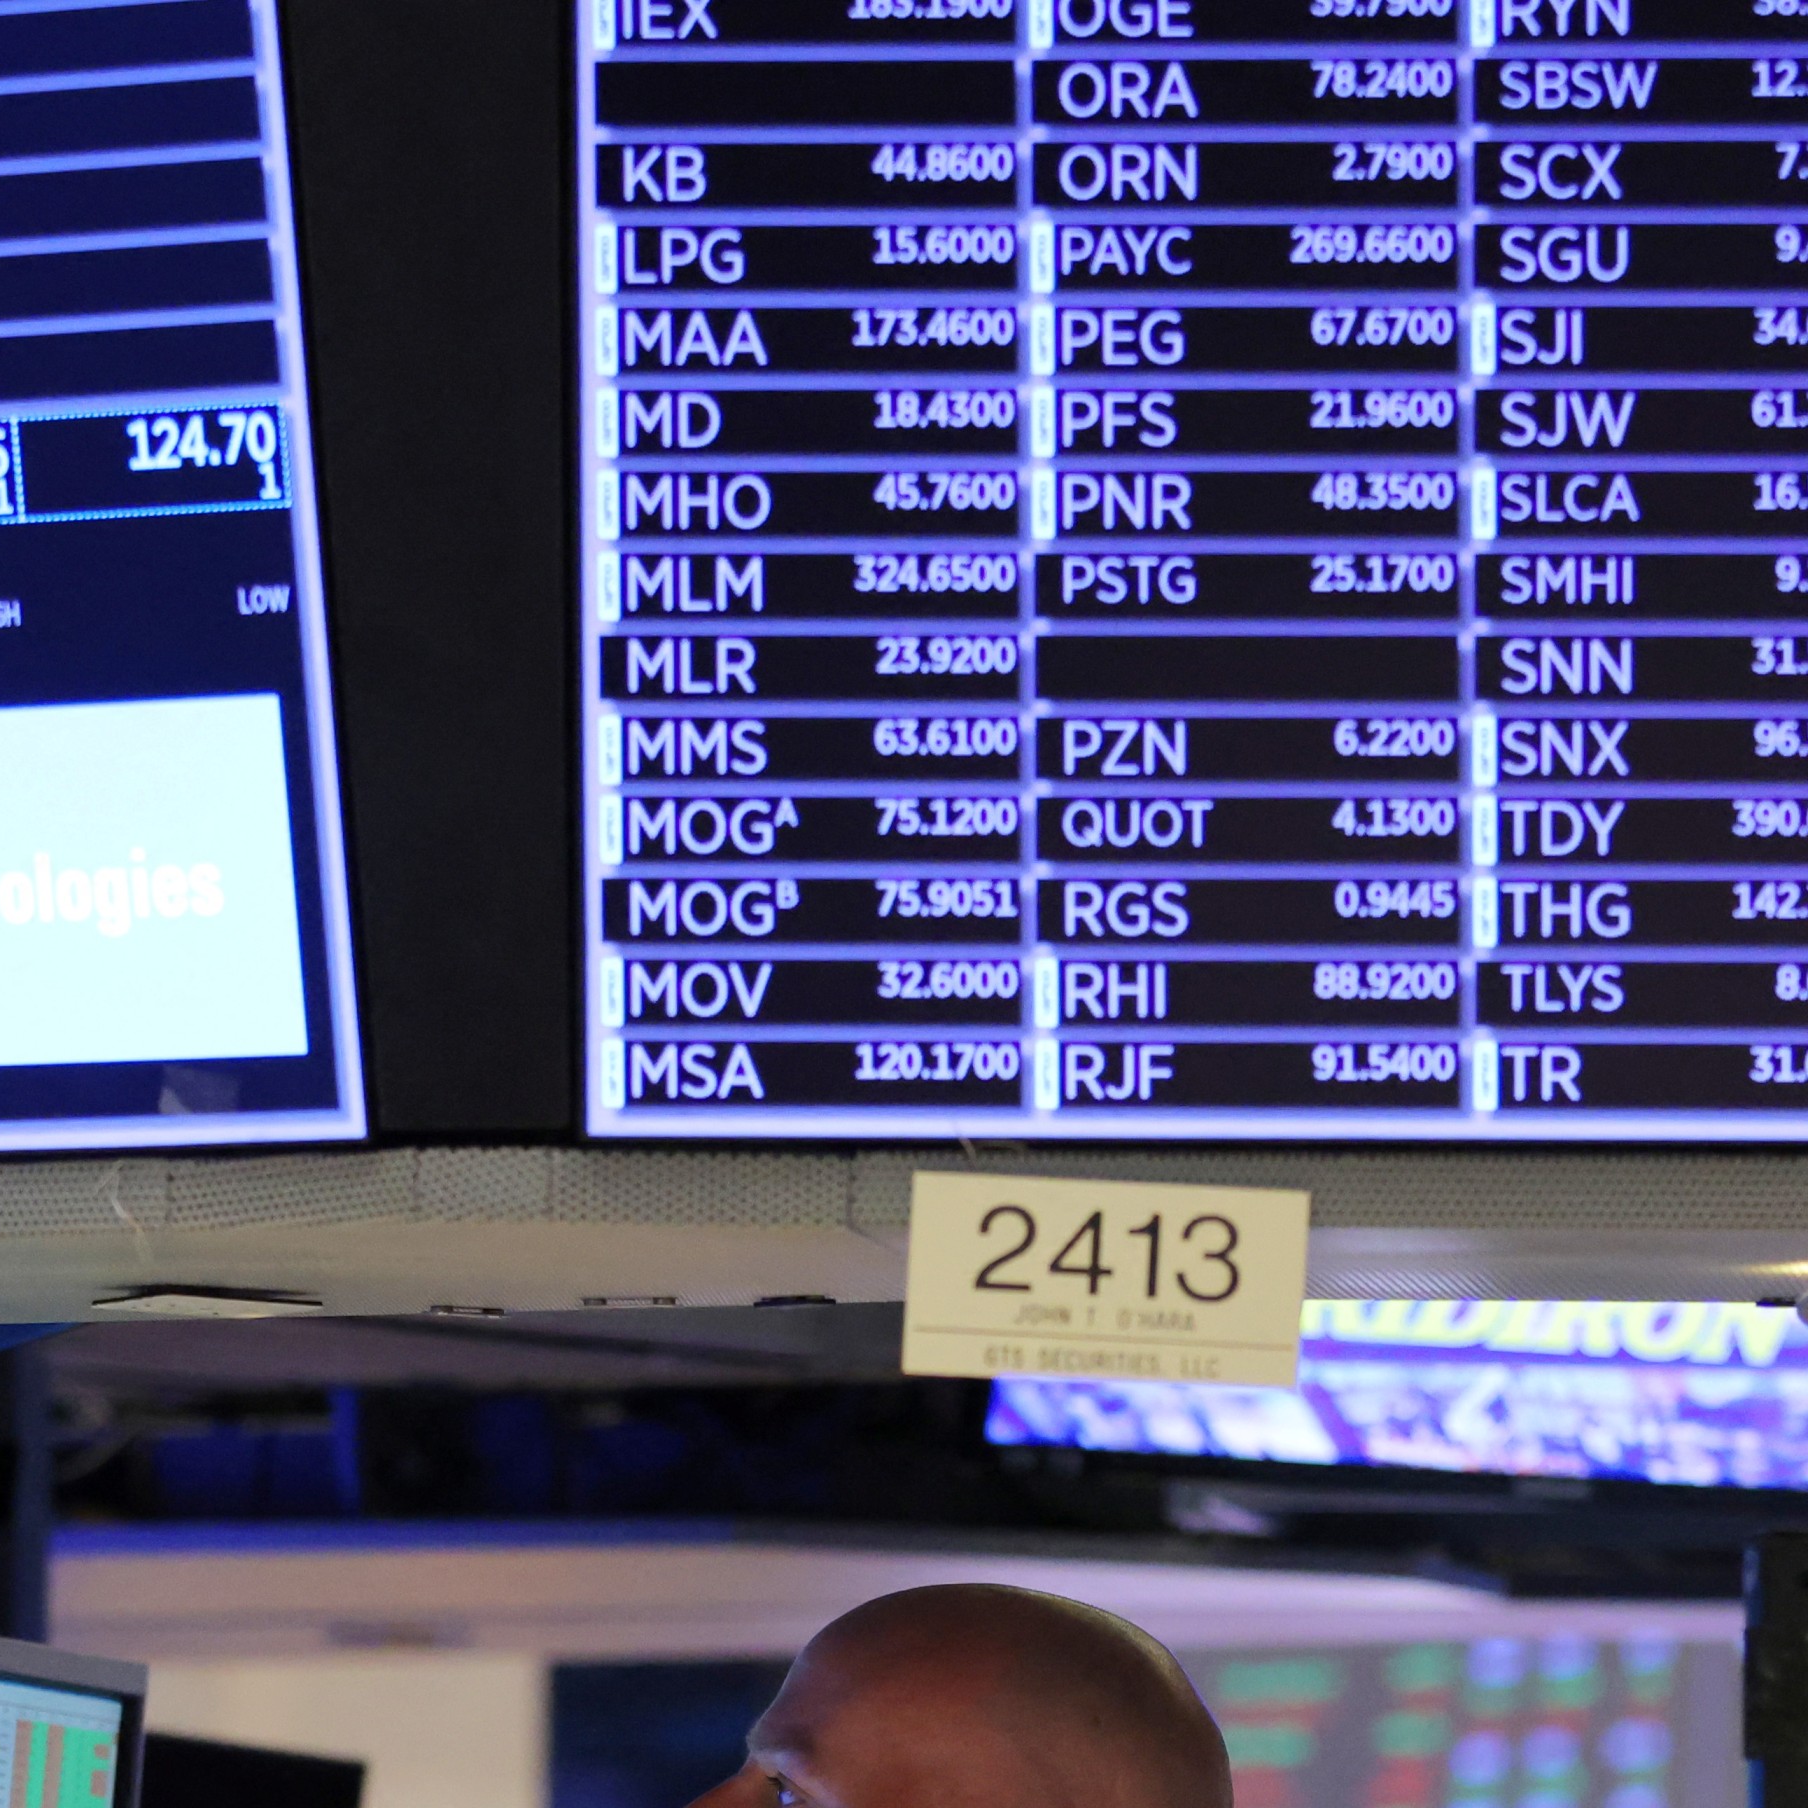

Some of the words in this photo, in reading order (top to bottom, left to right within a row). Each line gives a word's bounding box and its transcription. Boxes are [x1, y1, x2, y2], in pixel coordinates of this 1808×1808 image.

[624, 147, 705, 201] KB
[873, 145, 1012, 180] 44.8600
[1060, 146, 1196, 200] ORN
[1333, 143, 1453, 181] 2.7900
[1501, 145, 1619, 199] SCX
[626, 312, 766, 365] MAA
[854, 309, 1014, 345] 173.4600
[1062, 310, 1183, 364] PEG
[1312, 308, 1452, 344] 67.6700
[126, 411, 277, 474] 124.70
[1502, 393, 1633, 446] SJW
[260, 462, 283, 501] 1
[627, 476, 770, 529] MHO
[875, 473, 1015, 509] 45.7600
[239, 587, 289, 614] LOW
[1064, 721, 1185, 775] PZN
[1335, 720, 1454, 756] 6.2200
[1503, 721, 1627, 775] SNX
[876, 798, 1017, 835] 75.1200
[1063, 800, 1212, 847] QUOT
[1333, 799, 1454, 835] 4.1300
[1066, 964, 1165, 1017] RHI
[1315, 963, 1455, 999] 88.9200
[1502, 965, 1623, 1011] TLYS
[632, 1045, 763, 1098] MSA
[856, 1043, 1019, 1079] 120.1700
[974, 1205, 1240, 1302] 2413
